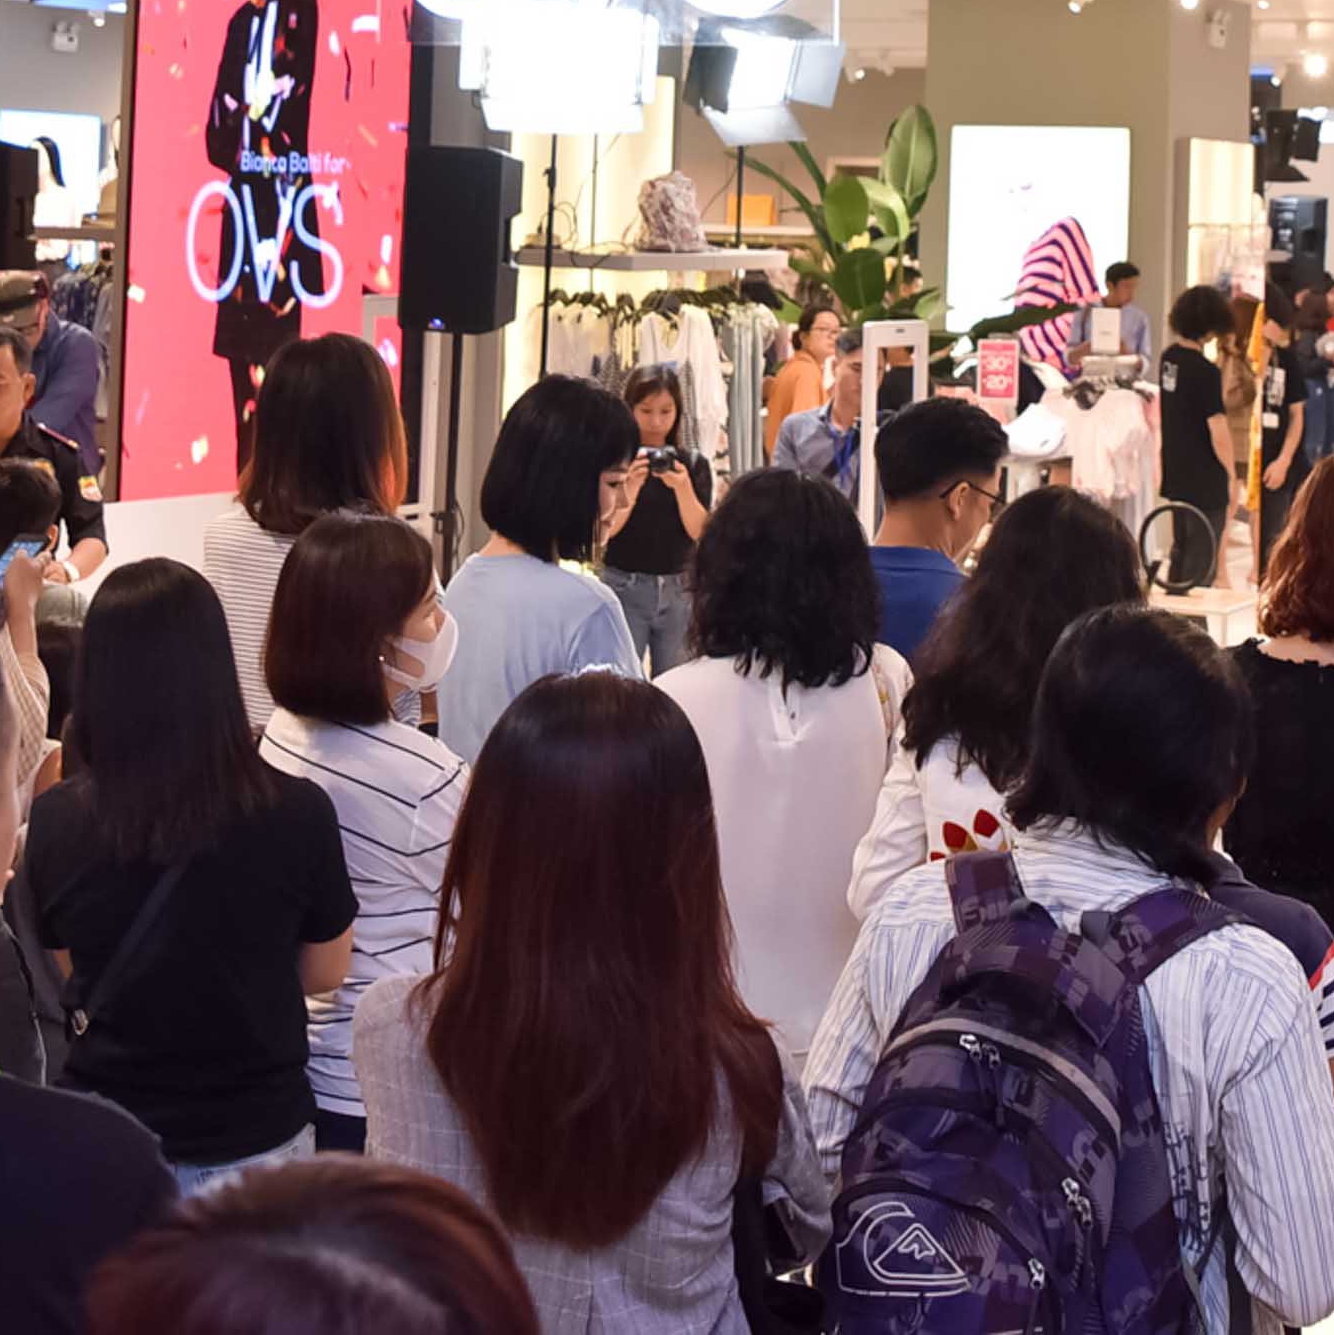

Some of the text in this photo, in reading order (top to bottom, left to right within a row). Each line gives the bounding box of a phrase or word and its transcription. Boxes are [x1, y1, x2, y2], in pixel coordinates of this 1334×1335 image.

[240, 149, 346, 174] Bianca Balti for
[186, 179, 345, 309] OVS
